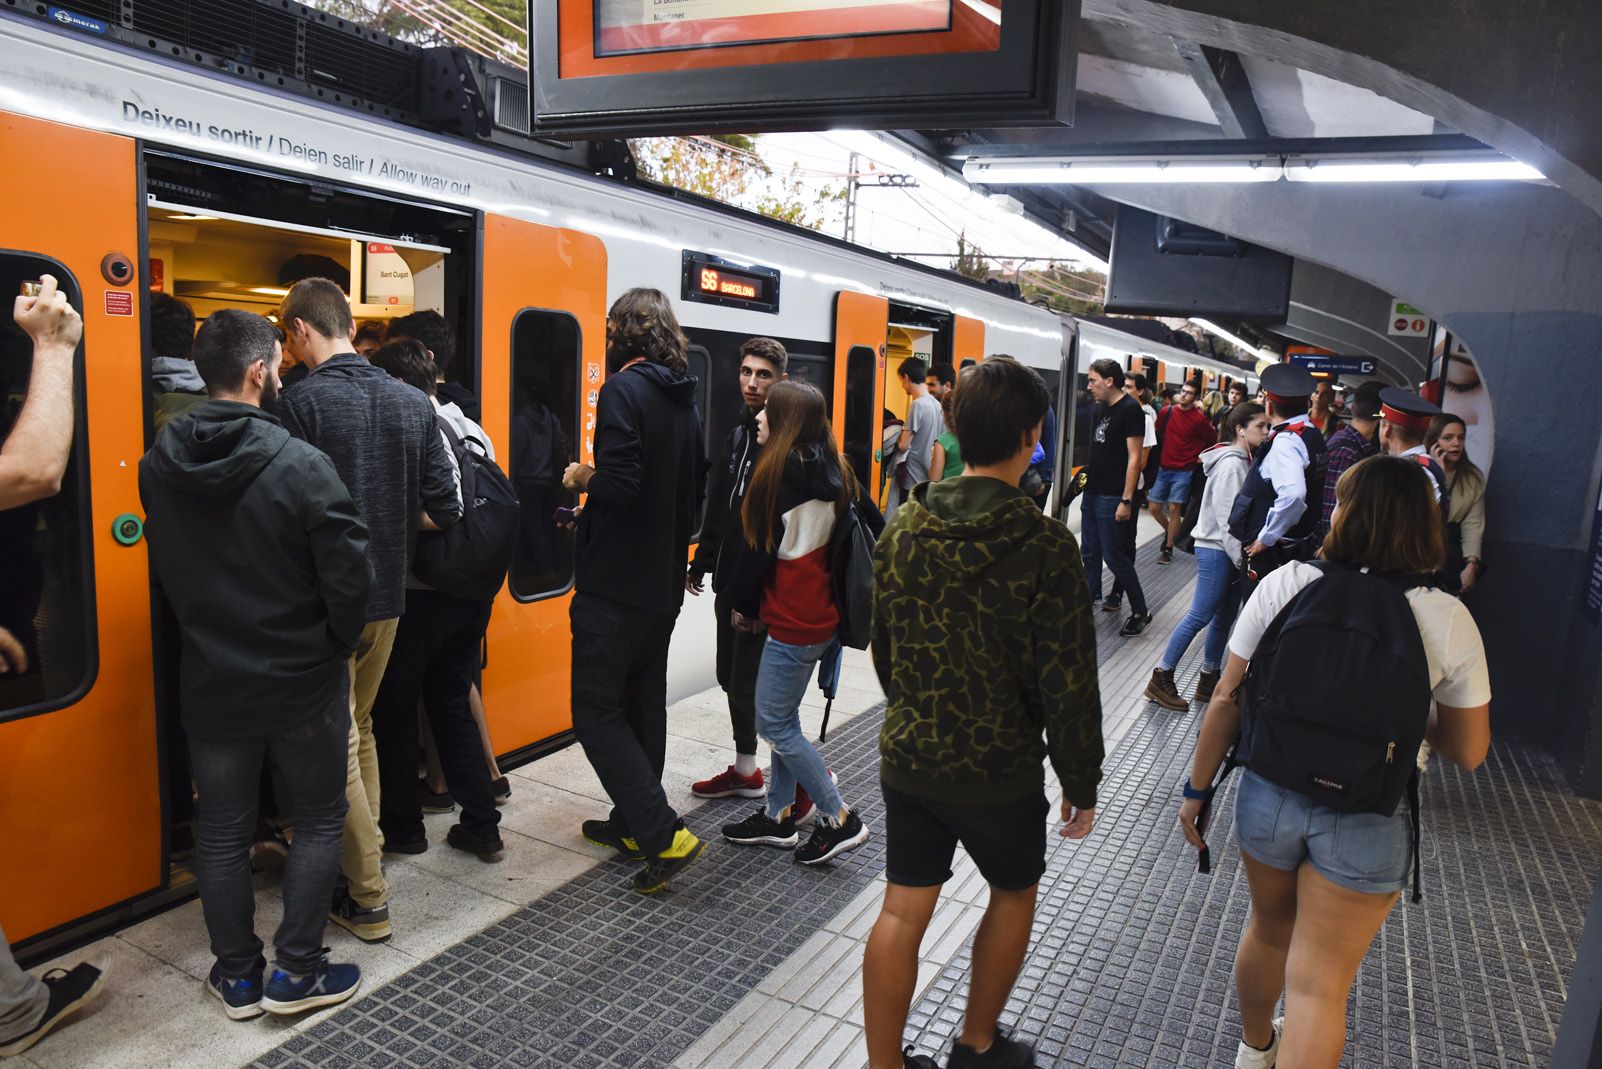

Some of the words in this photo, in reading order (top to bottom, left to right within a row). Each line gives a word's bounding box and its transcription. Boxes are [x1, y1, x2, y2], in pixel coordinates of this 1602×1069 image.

[122, 100, 201, 137] Deixeu
[208, 125, 262, 150] sortir
[266, 135, 274, 153] /
[332, 153, 365, 173] salir
[368, 158, 374, 175] /
[378, 161, 418, 185] Allow
[421, 174, 448, 193] way
[450, 181, 471, 197] out
[393, 271, 409, 279] Cugat
[701, 268, 718, 291] S6
[721, 281, 756, 298] BARCELONA
[915, 353, 929, 361] SOS
